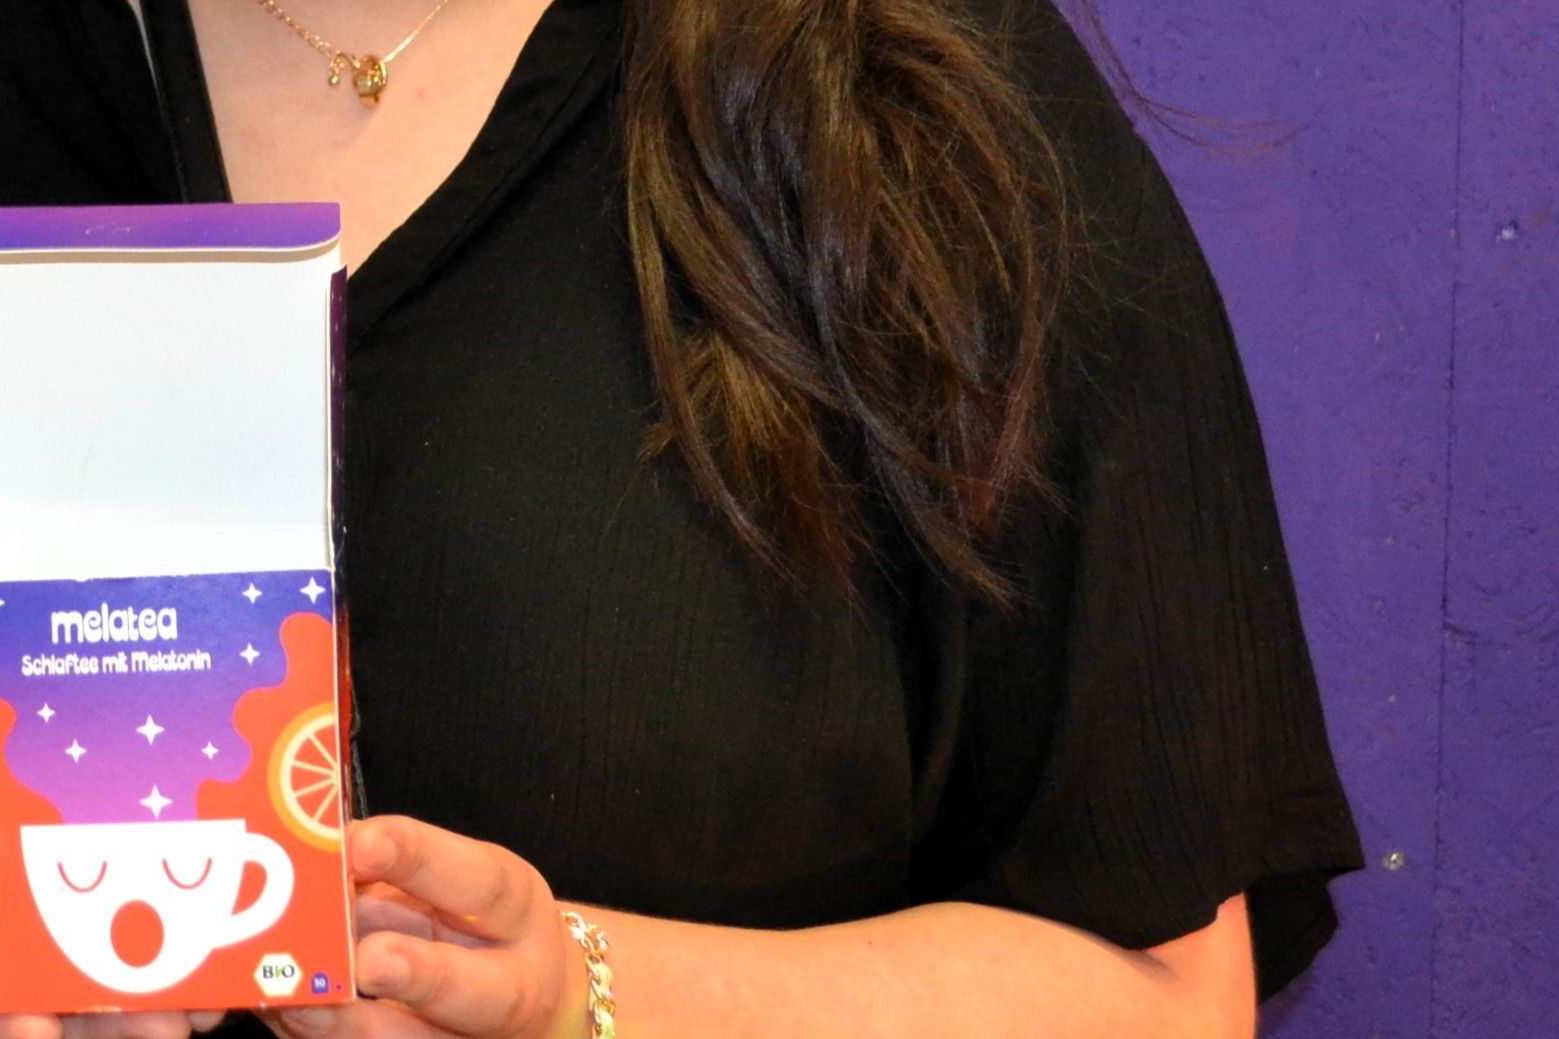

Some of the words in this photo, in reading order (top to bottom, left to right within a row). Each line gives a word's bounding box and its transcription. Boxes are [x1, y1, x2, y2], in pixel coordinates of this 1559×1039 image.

[50, 601, 178, 644] melatea
[21, 652, 100, 676] Schlaftee
[102, 650, 129, 674] mit
[131, 648, 211, 673] Melatonin
[262, 964, 295, 979] BIO
